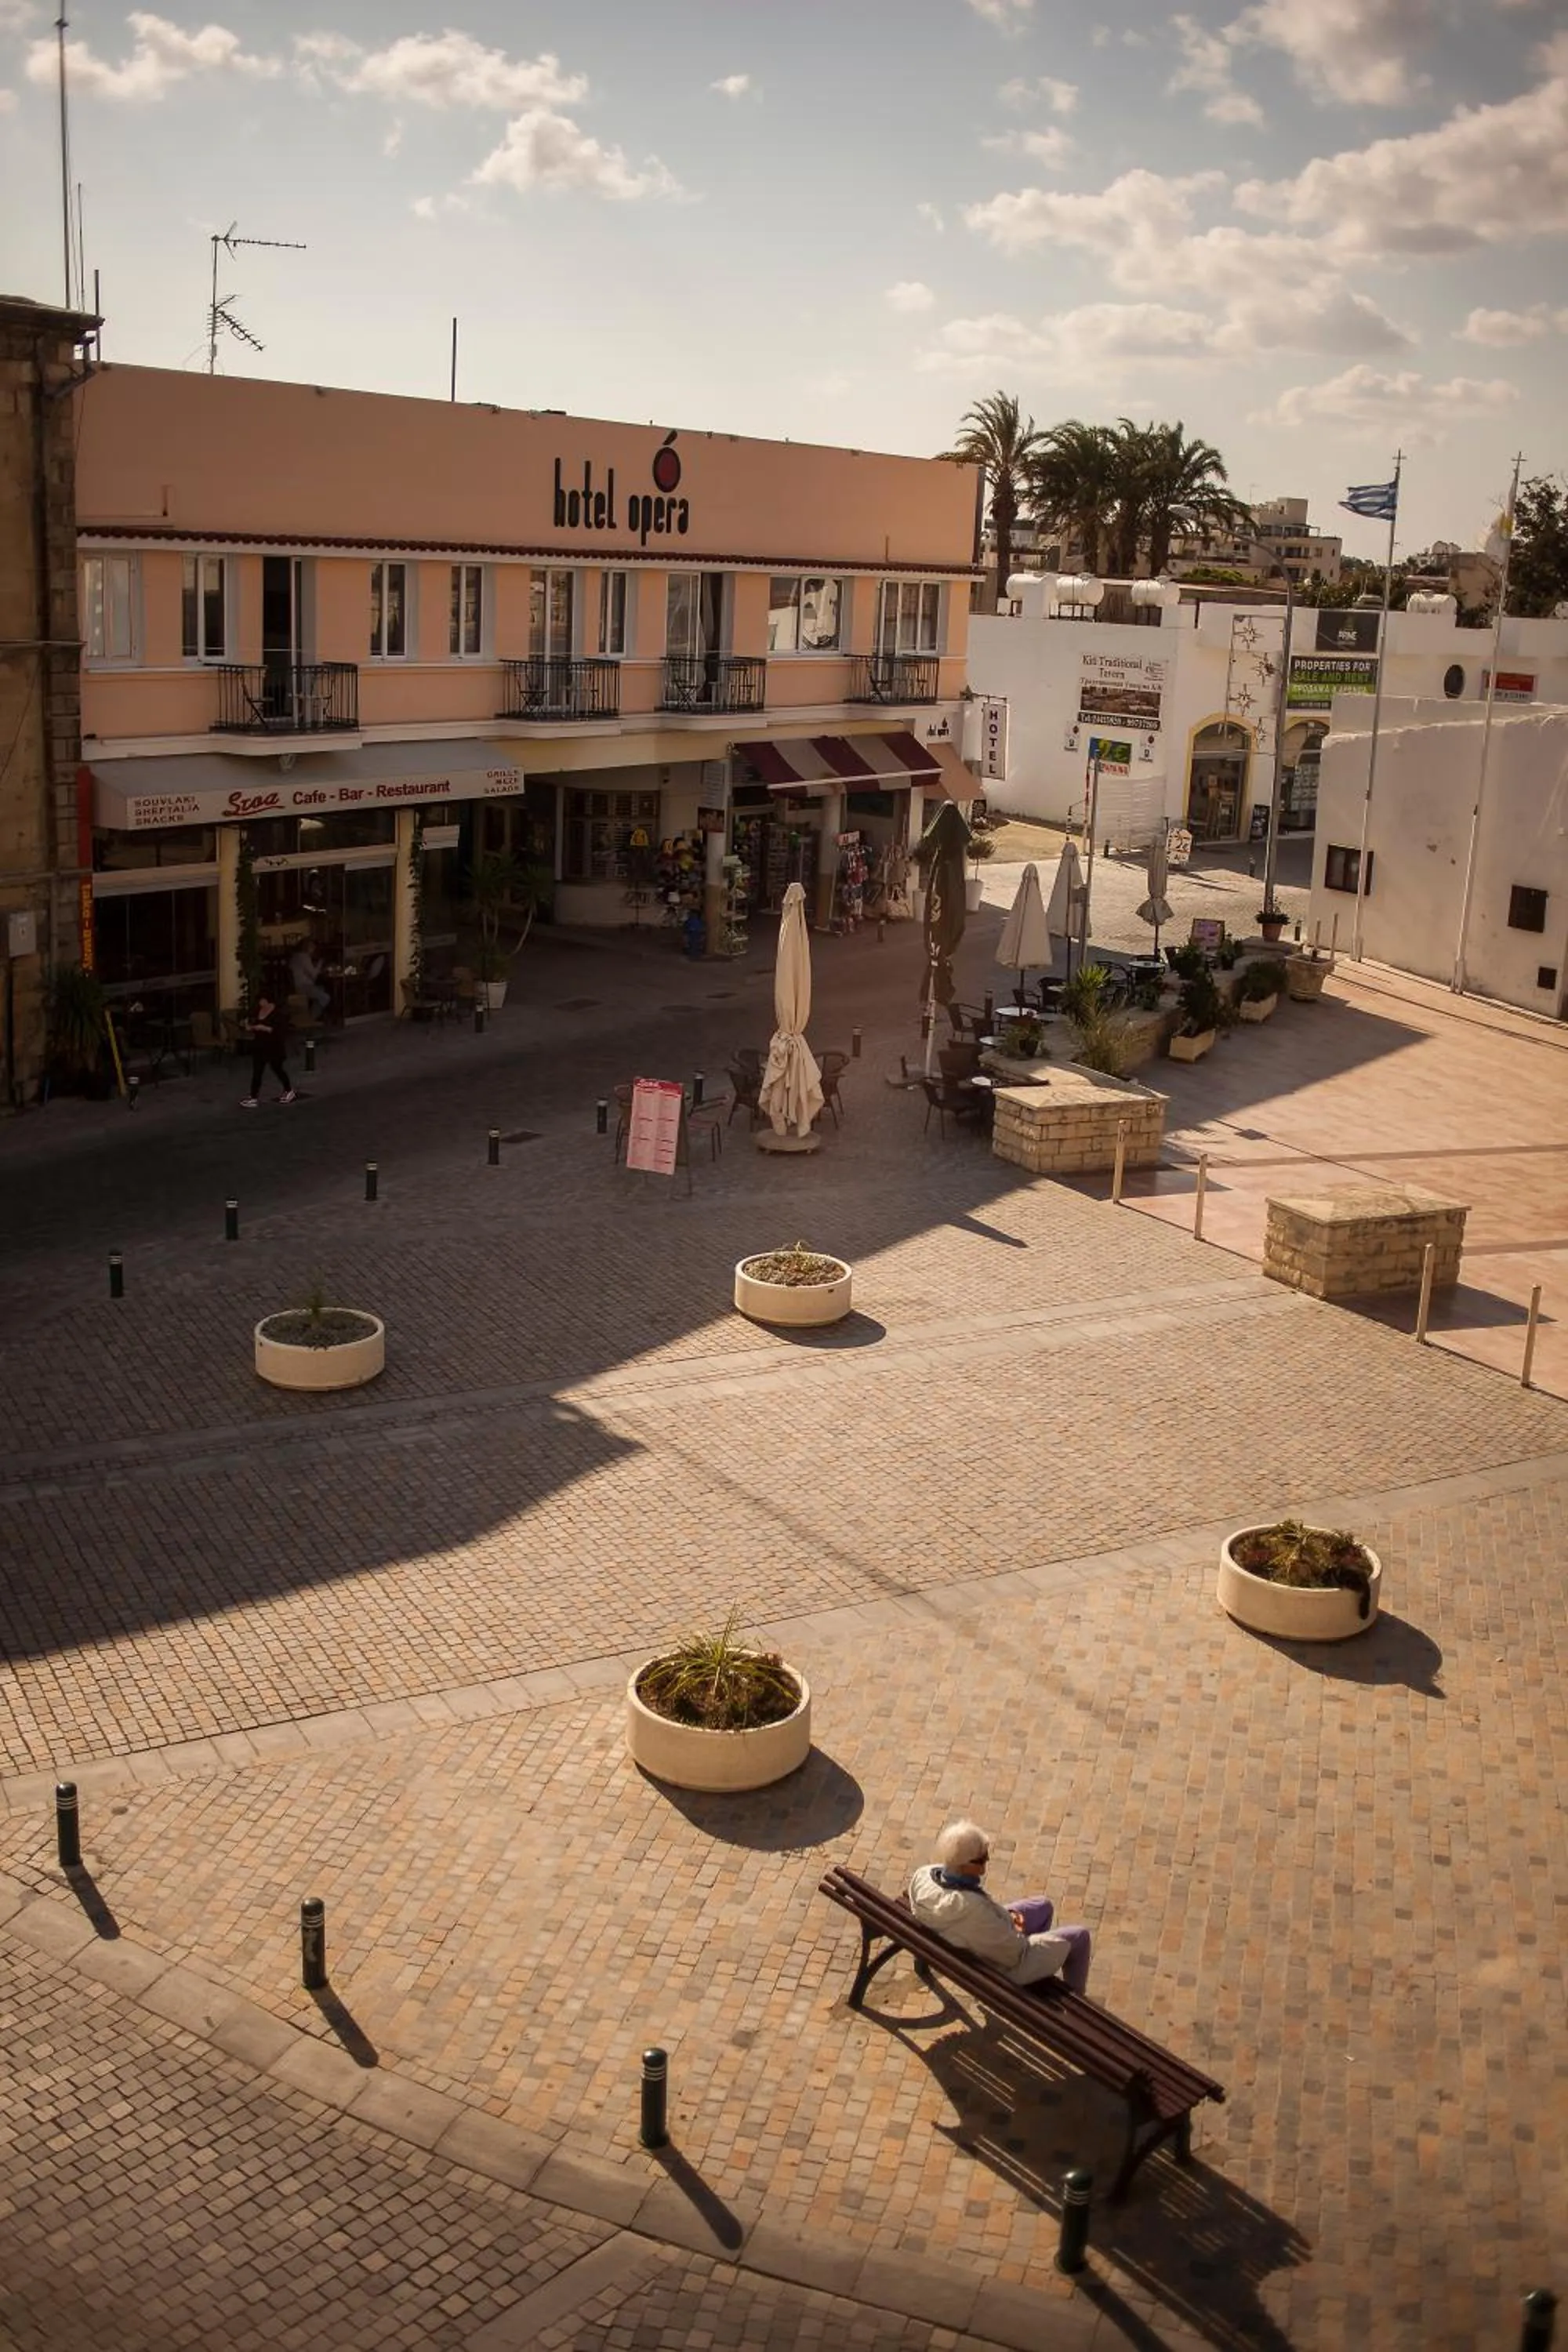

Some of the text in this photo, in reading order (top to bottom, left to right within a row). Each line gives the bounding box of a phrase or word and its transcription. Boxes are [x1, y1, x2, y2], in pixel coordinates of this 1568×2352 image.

[554, 457, 688, 546] hotel opera
[1098, 656, 1142, 670] Traditional
[1294, 660, 1371, 672] PROPERTIES FOR
[1293, 671, 1318, 681] SALE
[1321, 673, 1341, 682] AND
[989, 710, 998, 774] HOTEL
[292, 790, 327, 805] Cafe
[339, 788, 365, 801] Bar
[376, 780, 450, 797] Restaurant
[134, 796, 196, 807] SOUVLAKI
